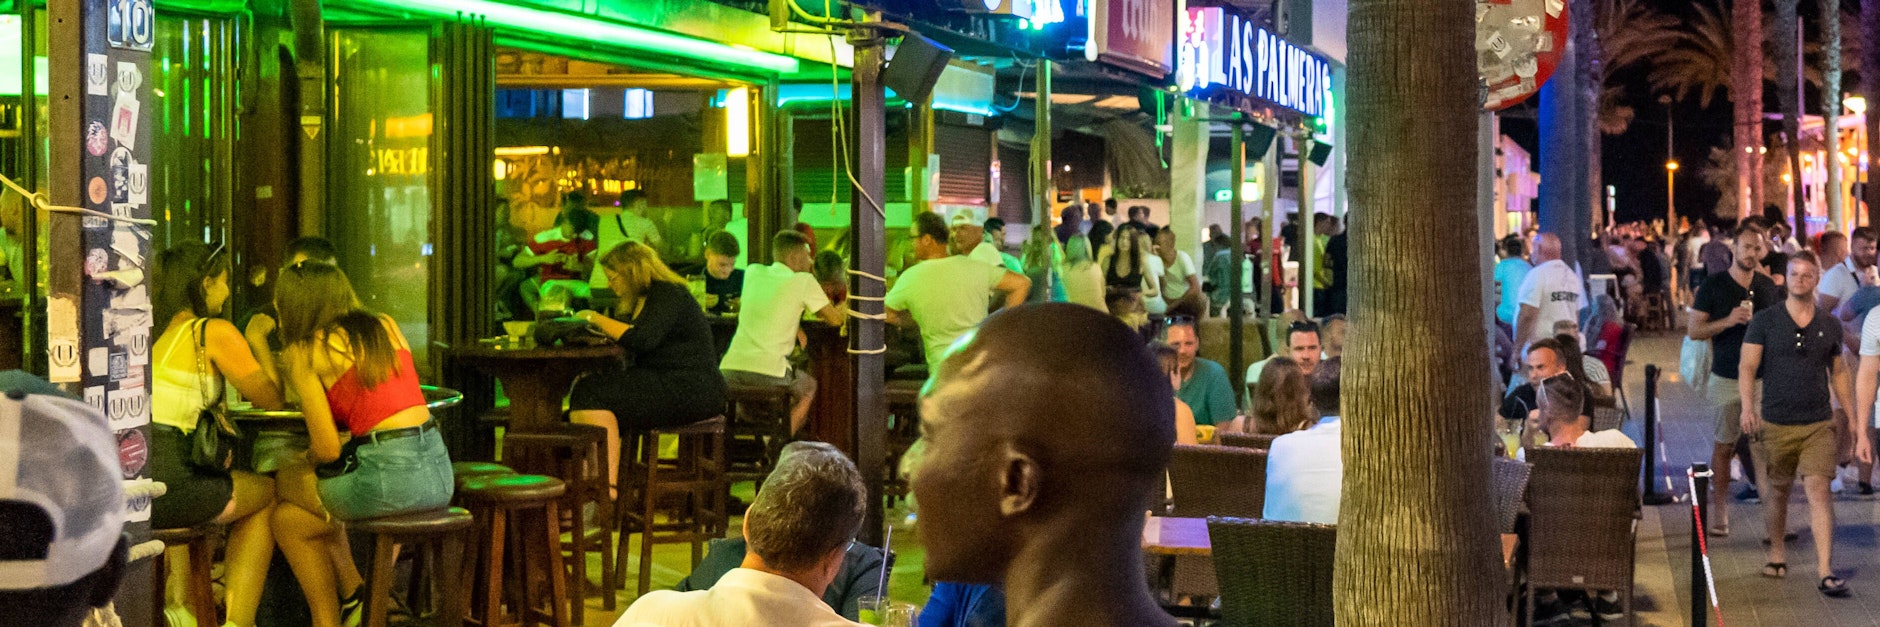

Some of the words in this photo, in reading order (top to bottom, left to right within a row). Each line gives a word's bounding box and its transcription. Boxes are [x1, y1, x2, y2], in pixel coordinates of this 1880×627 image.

[118, 0, 149, 44] 10
[1211, 7, 1254, 95] LAS
[1257, 27, 1332, 118] PALMERAS
